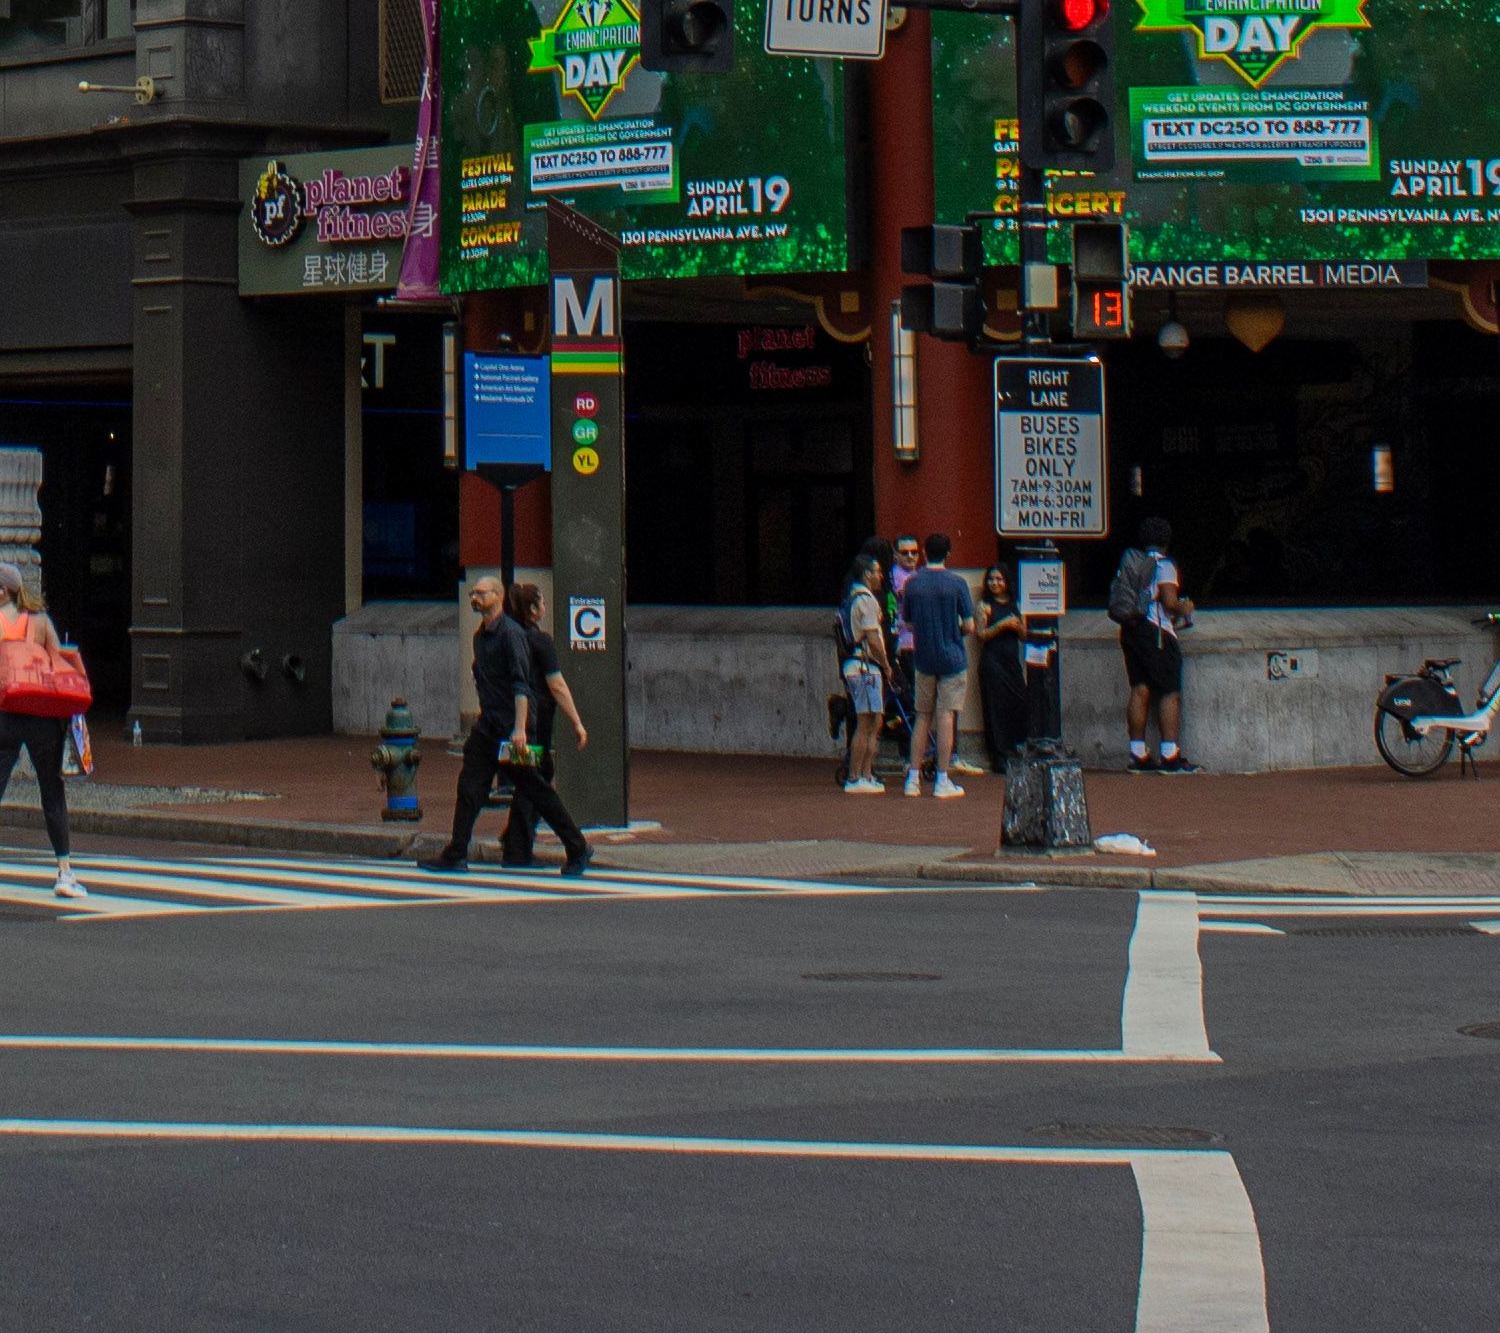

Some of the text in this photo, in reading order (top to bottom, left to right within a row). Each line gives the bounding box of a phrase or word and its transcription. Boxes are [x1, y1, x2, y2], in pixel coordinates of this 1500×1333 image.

[1203, 15, 1301, 54] DAY
[565, 50, 626, 89] DAY
[1143, 101, 1368, 114] WEEKEND EVENTS FROM DC GOVERNMENT
[1167, 90, 1344, 104] GET UPDATES ON EMANCIPATION
[1152, 119, 1361, 137] TEXT DC250 TO 888-777
[461, 153, 514, 179] FESTIVAL
[534, 154, 558, 169] TEXT
[601, 149, 616, 163] TO
[618, 145, 667, 162] 888-777
[1389, 159, 1461, 176] SUNDAY
[303, 166, 402, 216] planet
[687, 174, 791, 215] SUNDAY 19
[1390, 175, 1467, 198] APRIL
[263, 192, 286, 226] pf
[461, 189, 507, 212] PARADE
[686, 196, 747, 219] APRIL
[992, 191, 1127, 216] CCERT
[1300, 209, 1335, 223] 1301
[1337, 208, 1450, 224] PENNSYLVANIA
[1452, 208, 1484, 223] AVE.
[460, 221, 522, 248] CONCERT
[621, 230, 646, 245] 1301
[648, 226, 733, 244] PENNSYLVANIA
[765, 224, 788, 238] NW
[302, 249, 390, 286] 星球健身
[1224, 264, 1313, 286] BARREL
[1324, 263, 1401, 286] MEDIA
[554, 277, 615, 338] M
[1092, 291, 1123, 327] 13
[736, 325, 816, 361] planet
[748, 360, 833, 390] fitness
[1028, 369, 1070, 387] RIGHT
[576, 398, 595, 411] RD
[1030, 391, 1069, 408] LANE
[575, 426, 597, 439] GR
[1020, 415, 1080, 435] BUSES
[1024, 437, 1078, 456] BIKES
[578, 454, 595, 468] YL
[1025, 458, 1076, 477] ONLY
[1011, 479, 1092, 494] 7AM-9:30AM
[1011, 495, 1092, 509] 4PM-6:30PM
[1018, 511, 1086, 529] MON-FRI
[575, 607, 601, 639] C
